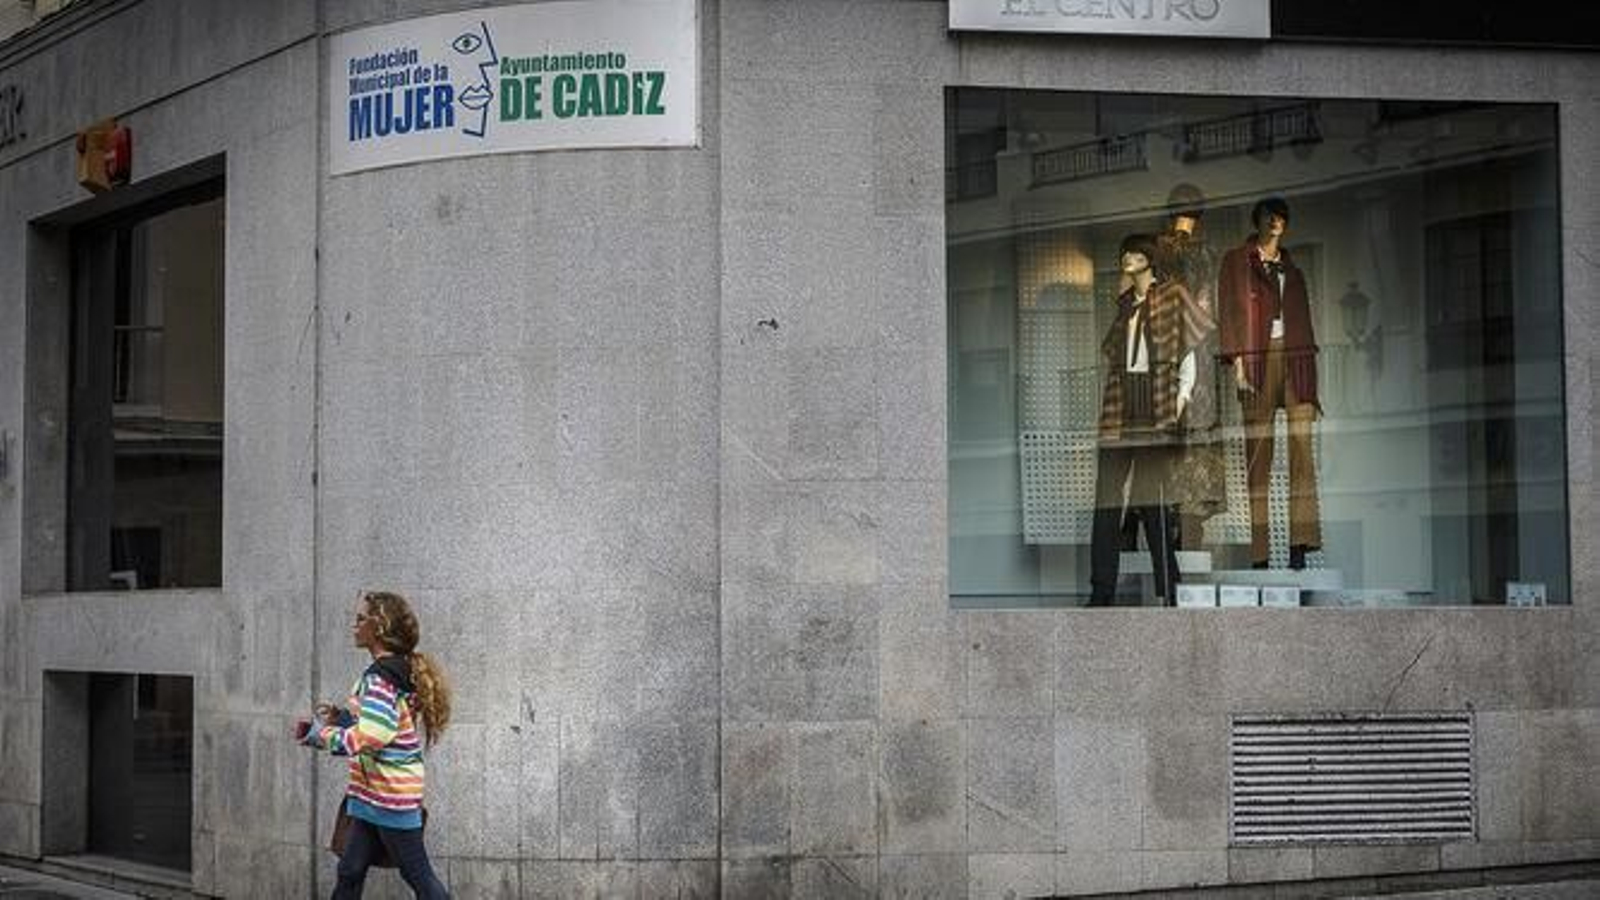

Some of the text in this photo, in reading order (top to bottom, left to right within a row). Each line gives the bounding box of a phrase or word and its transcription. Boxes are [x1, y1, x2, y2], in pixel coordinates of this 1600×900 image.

[349, 47, 418, 76] Fundación
[500, 51, 626, 76] Ayuntamiento
[349, 63, 449, 96] Municipal de la
[349, 84, 455, 141] MUJER
[500, 76, 543, 122] DE
